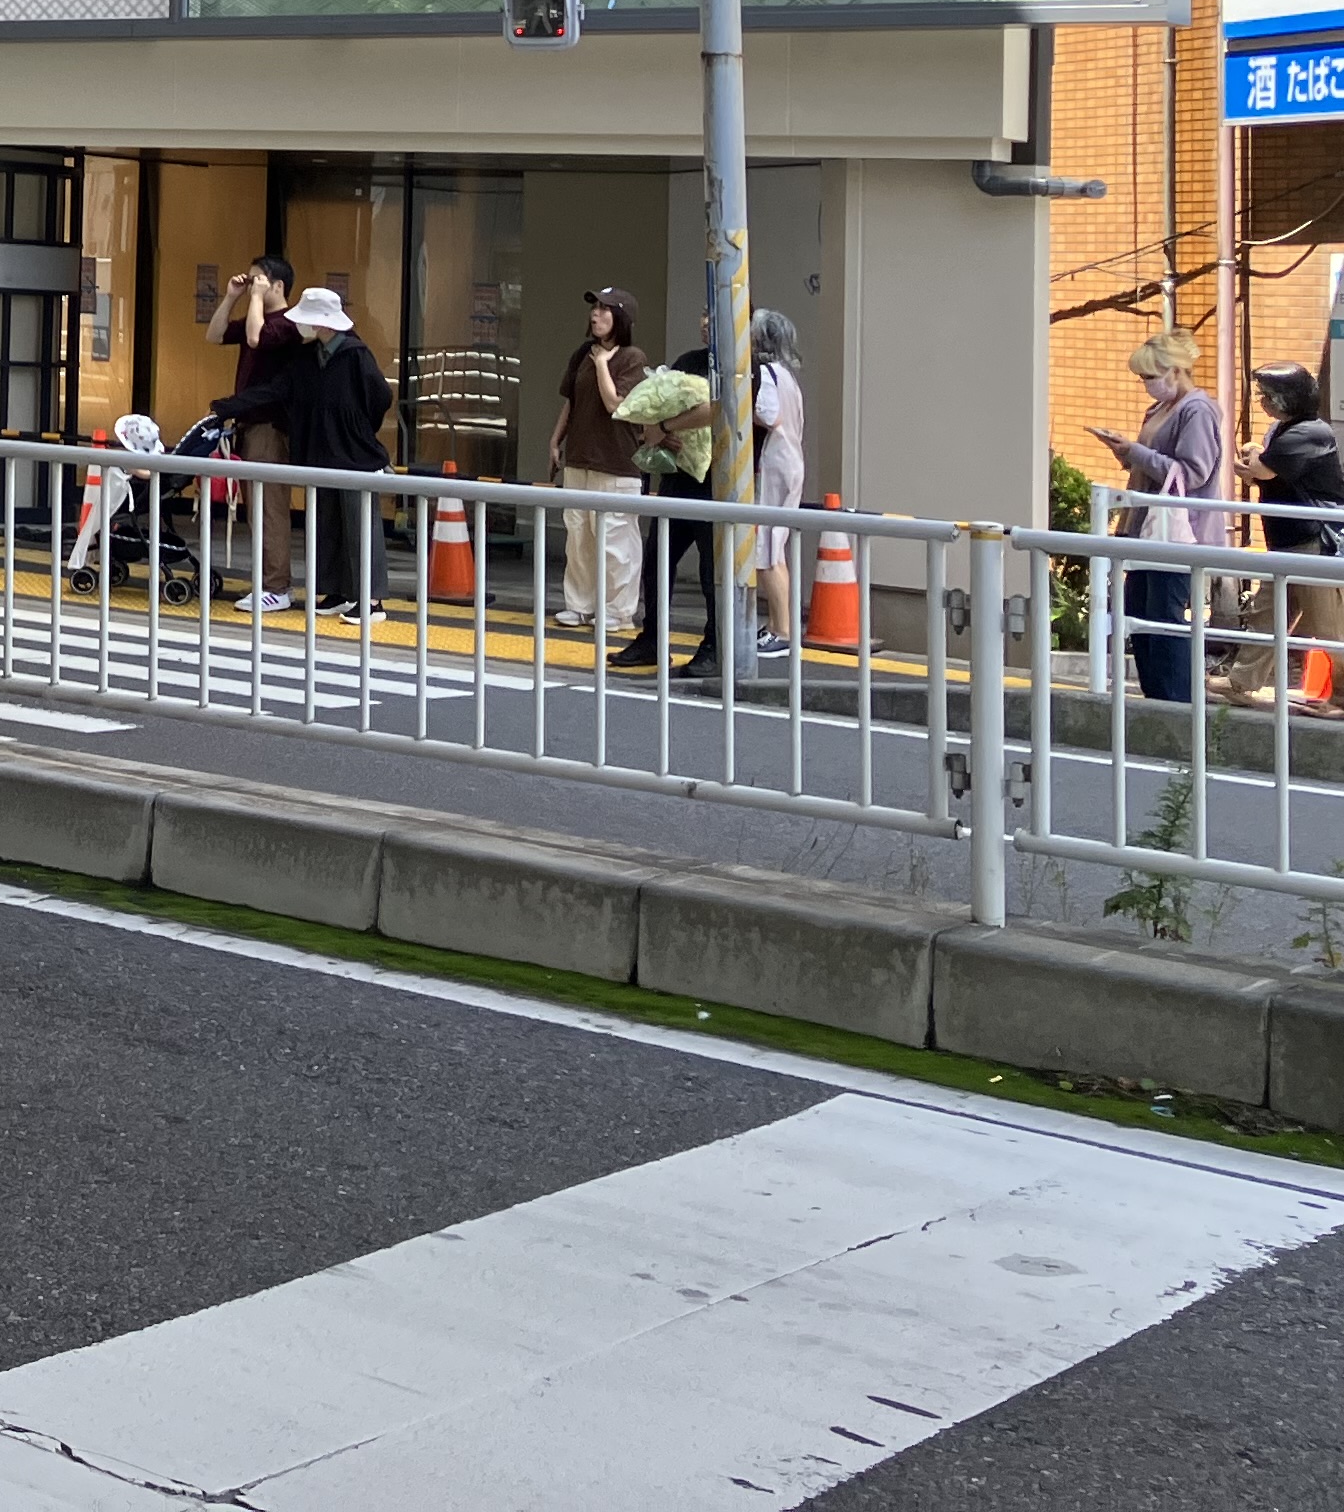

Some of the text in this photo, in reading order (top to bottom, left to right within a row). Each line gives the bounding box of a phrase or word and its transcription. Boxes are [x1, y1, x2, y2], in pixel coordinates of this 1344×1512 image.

[1247, 55, 1344, 111] 酒 たばこ
